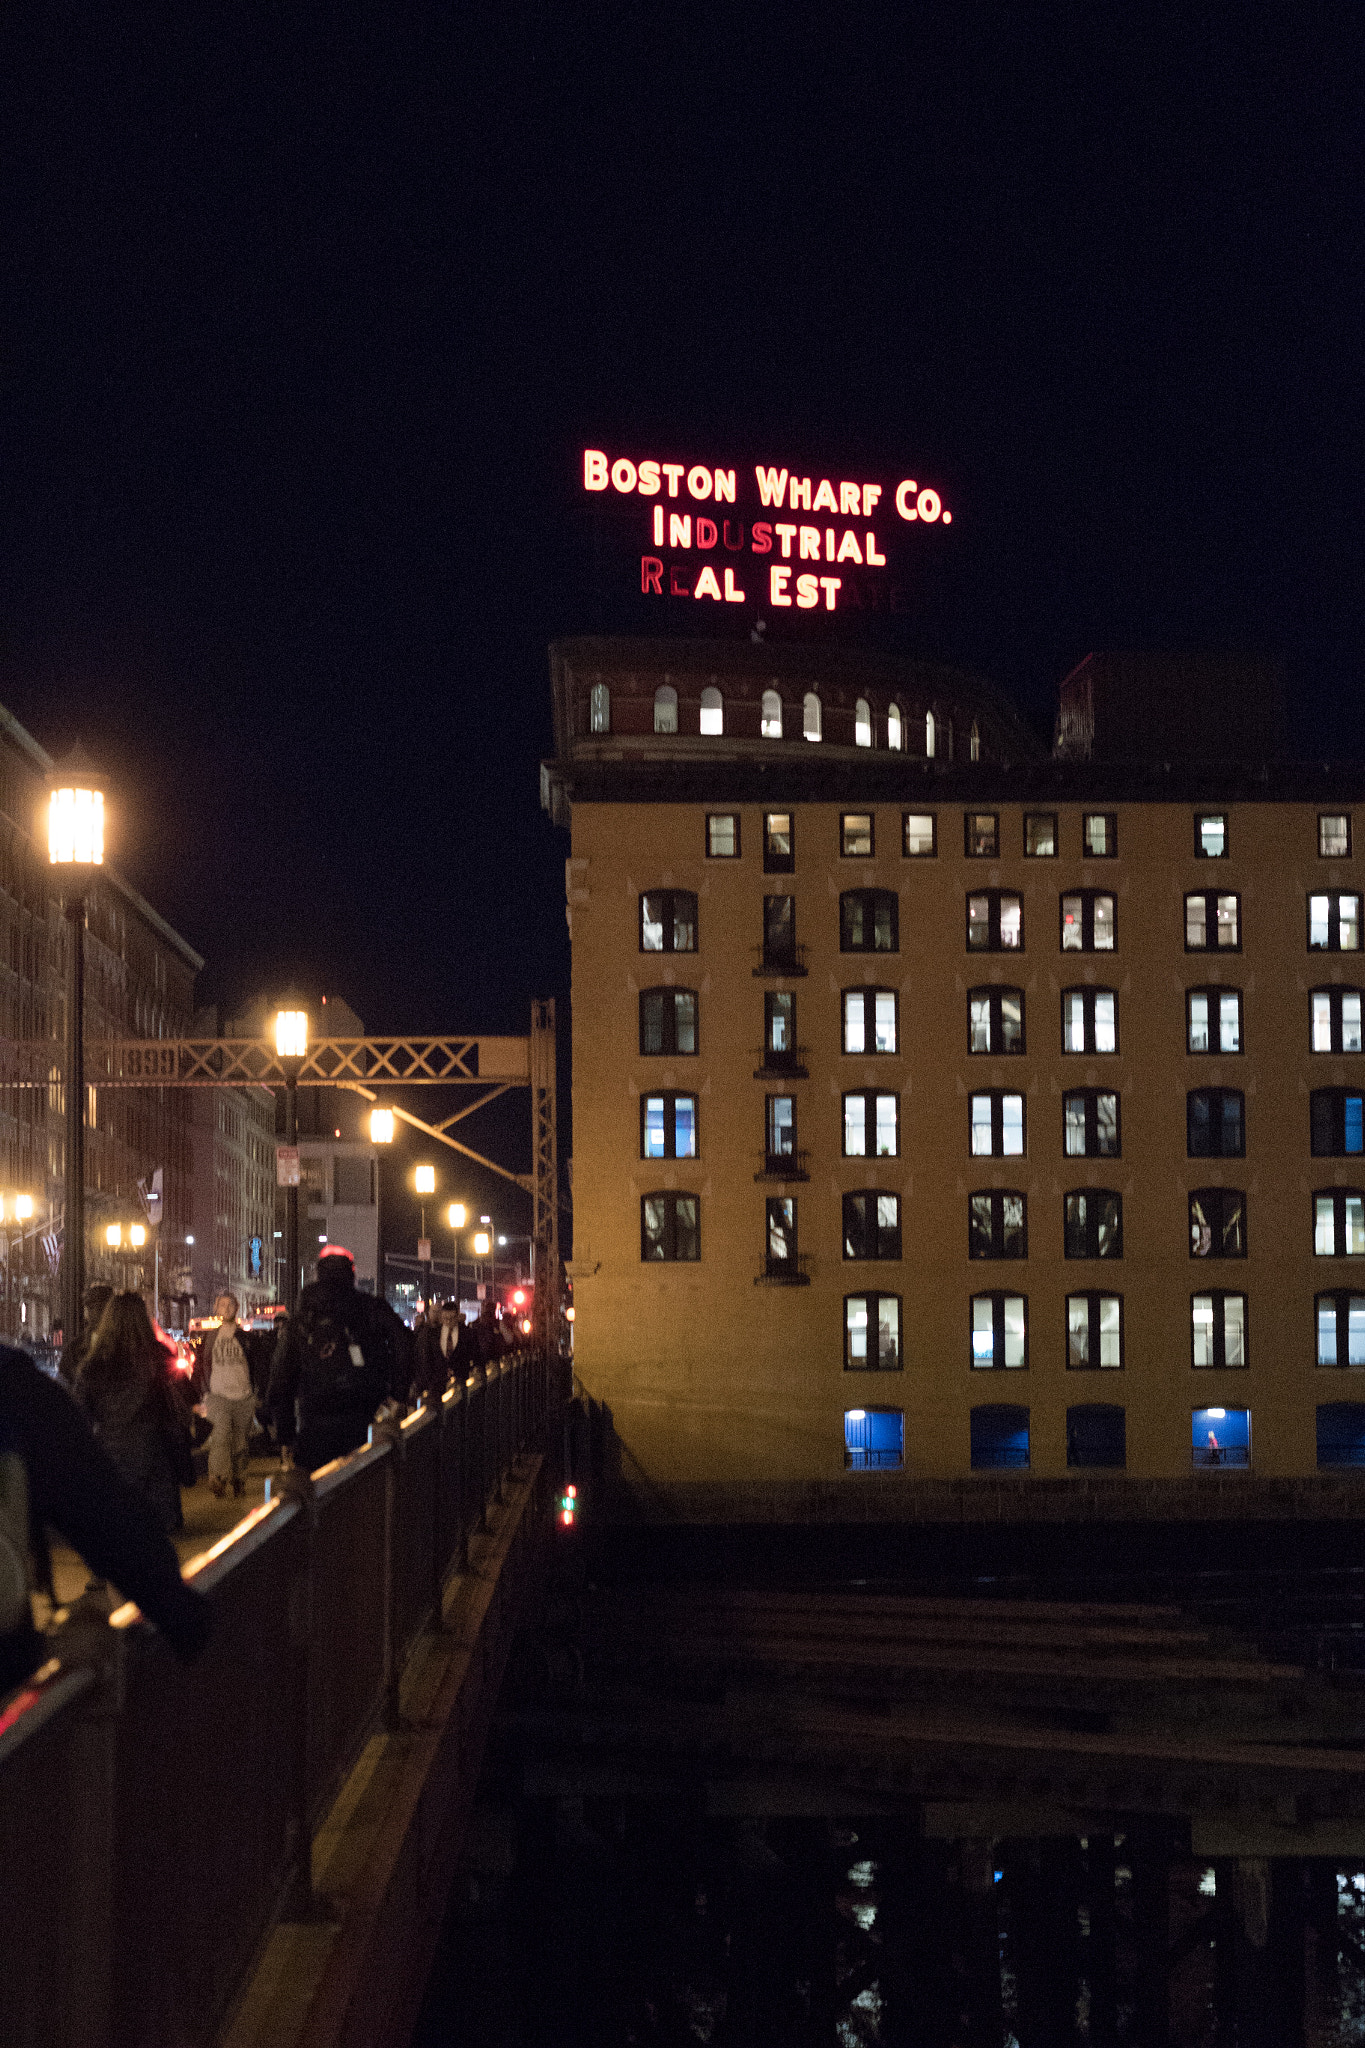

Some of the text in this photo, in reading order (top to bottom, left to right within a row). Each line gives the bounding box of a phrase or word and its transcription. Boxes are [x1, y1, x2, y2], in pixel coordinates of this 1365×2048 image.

[583, 448, 952, 524] BOSTON WHARF CO.
[652, 504, 887, 567] INDUSTRIAL
[641, 555, 745, 602] REAL
